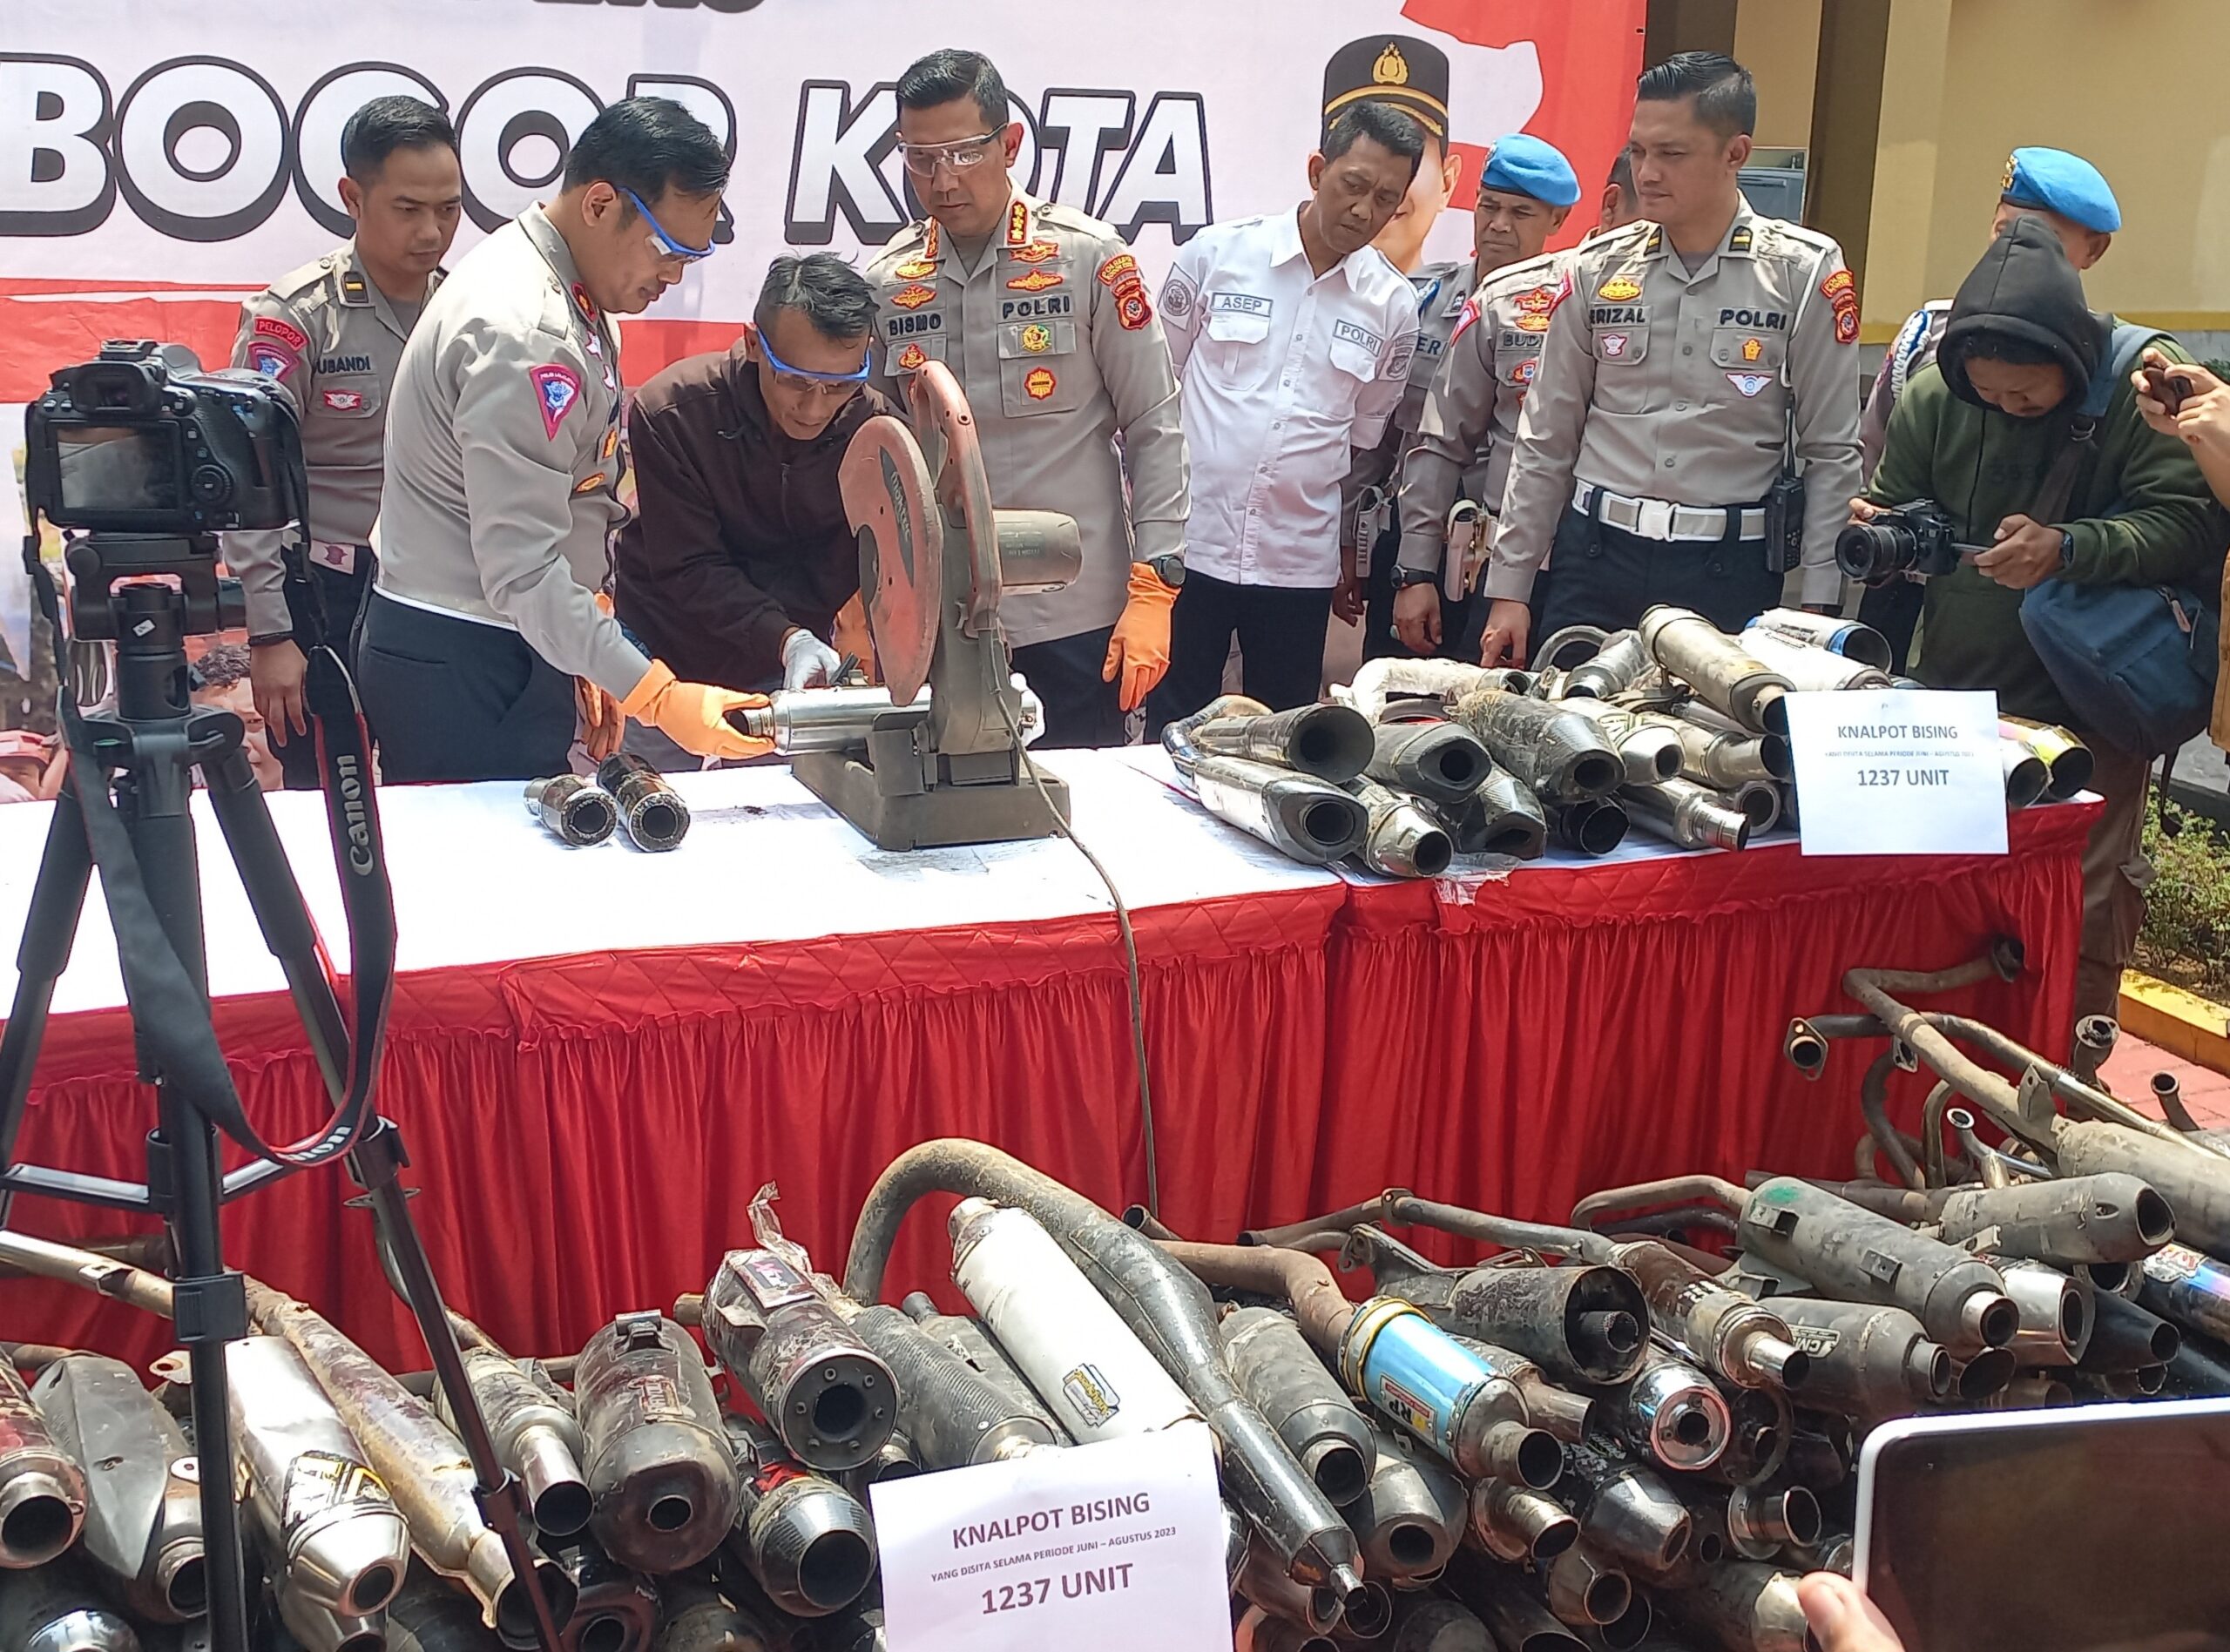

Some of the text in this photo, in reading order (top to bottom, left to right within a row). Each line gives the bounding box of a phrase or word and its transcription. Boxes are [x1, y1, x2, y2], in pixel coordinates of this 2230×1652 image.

[785, 78, 1214, 246] KTA
[1002, 295, 1071, 320] POLRI
[1221, 294, 1262, 312] ASEP
[889, 313, 942, 336] BISMO
[1720, 308, 1787, 331] POLRI
[258, 320, 301, 347] PELOPOR
[1341, 325, 1378, 351] POLRI
[1837, 725, 1958, 739] KNALPOT BISING
[1857, 769, 1950, 786] 1237 UNIT
[336, 754, 375, 876] Canon
[952, 1492, 1151, 1549] KNALPOT BISING
[930, 1568, 959, 1582] YANG
[960, 1561, 992, 1576] DISITA
[992, 1554, 1032, 1568] SELAMA
[1033, 1545, 1075, 1561] PERIODE
[1077, 1541, 1098, 1554] JUNI
[1108, 1530, 1152, 1547] AGUSTUS
[1154, 1526, 1177, 1540] 2023
[981, 1562, 1134, 1615] 1237 UNIT
